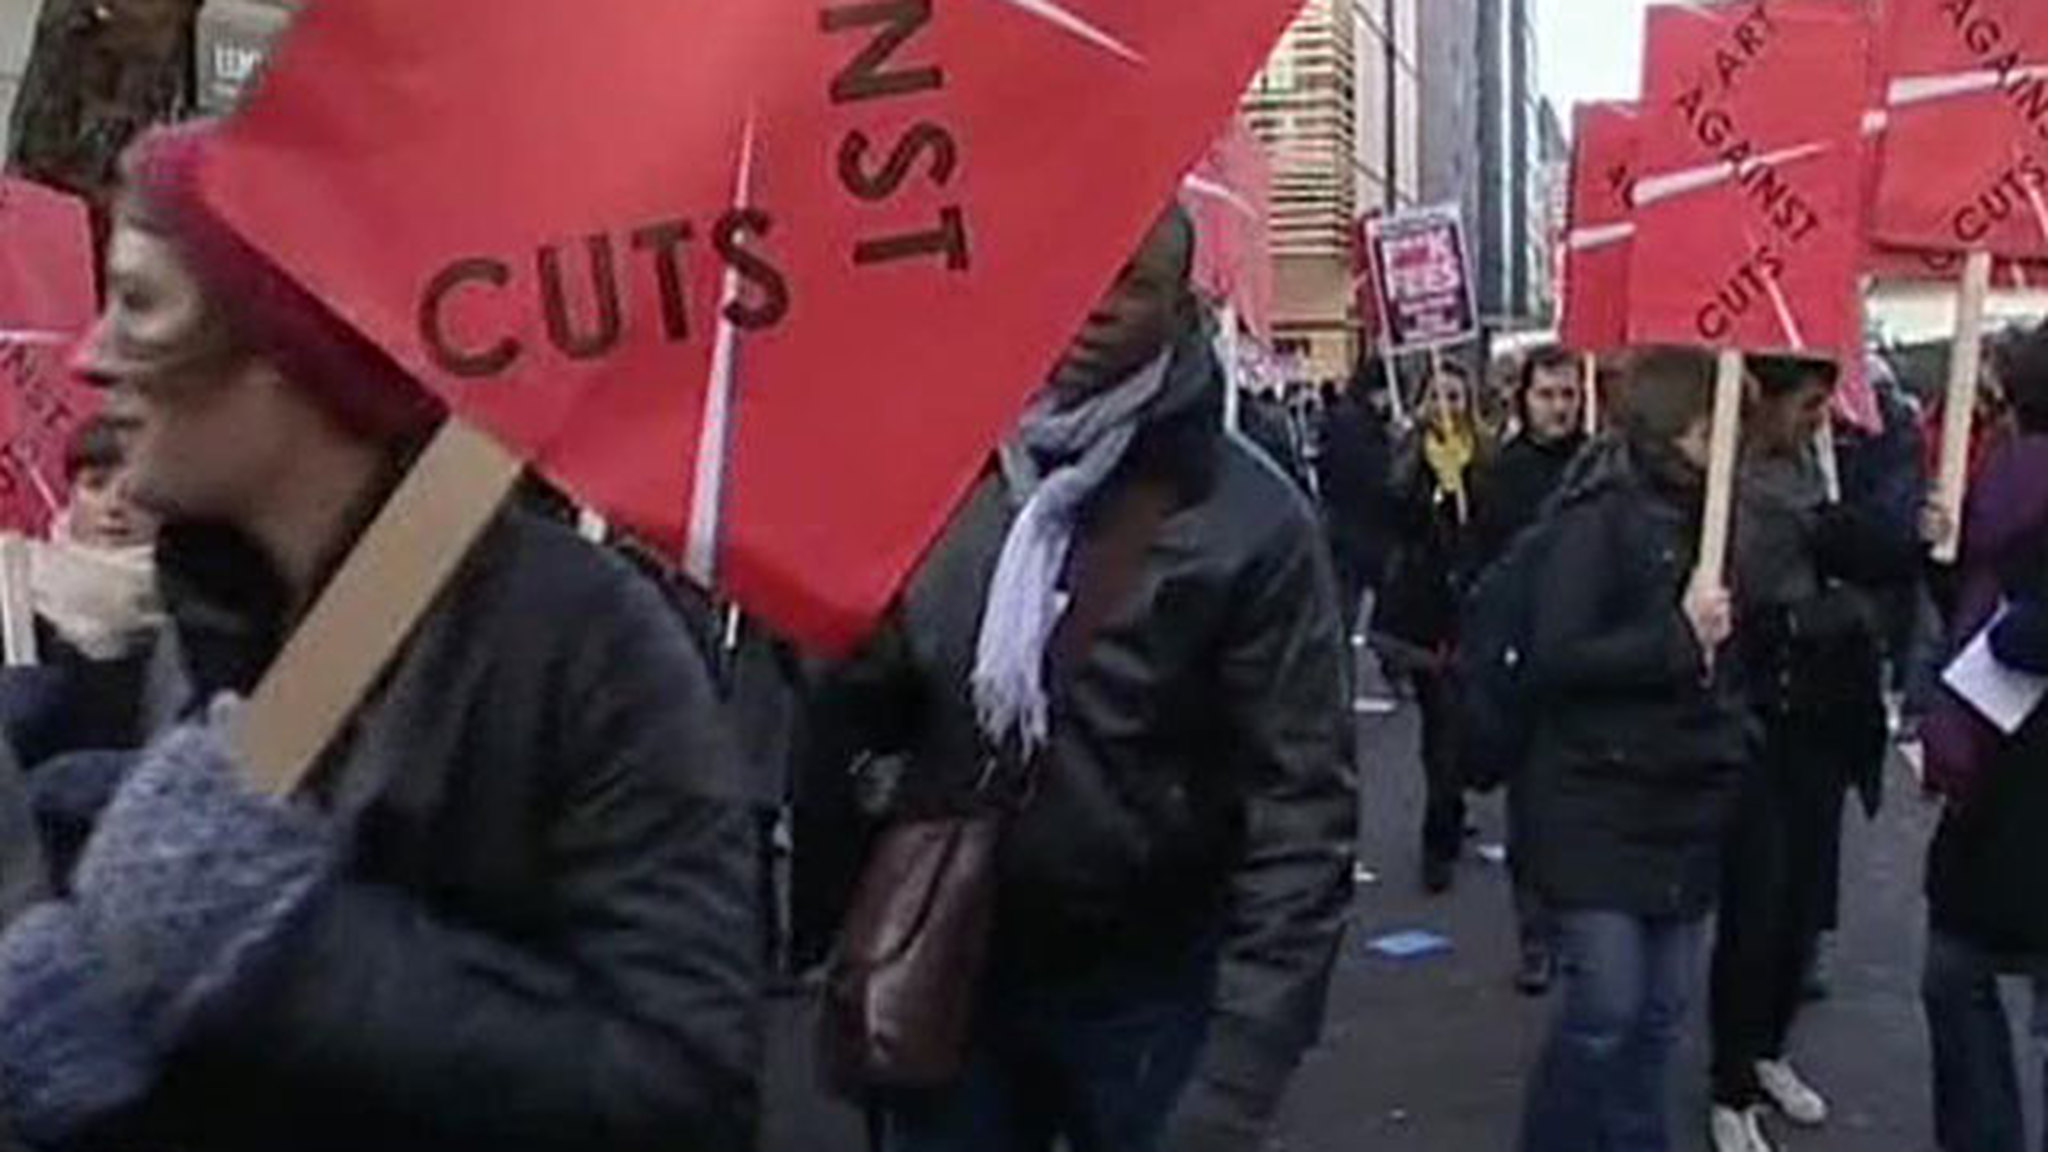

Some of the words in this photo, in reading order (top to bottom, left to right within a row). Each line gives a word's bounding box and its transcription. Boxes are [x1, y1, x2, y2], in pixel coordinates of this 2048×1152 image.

[1714, 5, 1774, 86] ART
[820, 0, 969, 271] NST
[1674, 88, 1820, 243] AGAINST
[1952, 155, 2046, 242] CUTS
[418, 206, 792, 378] CUTS
[1696, 246, 1784, 340] CUTS
